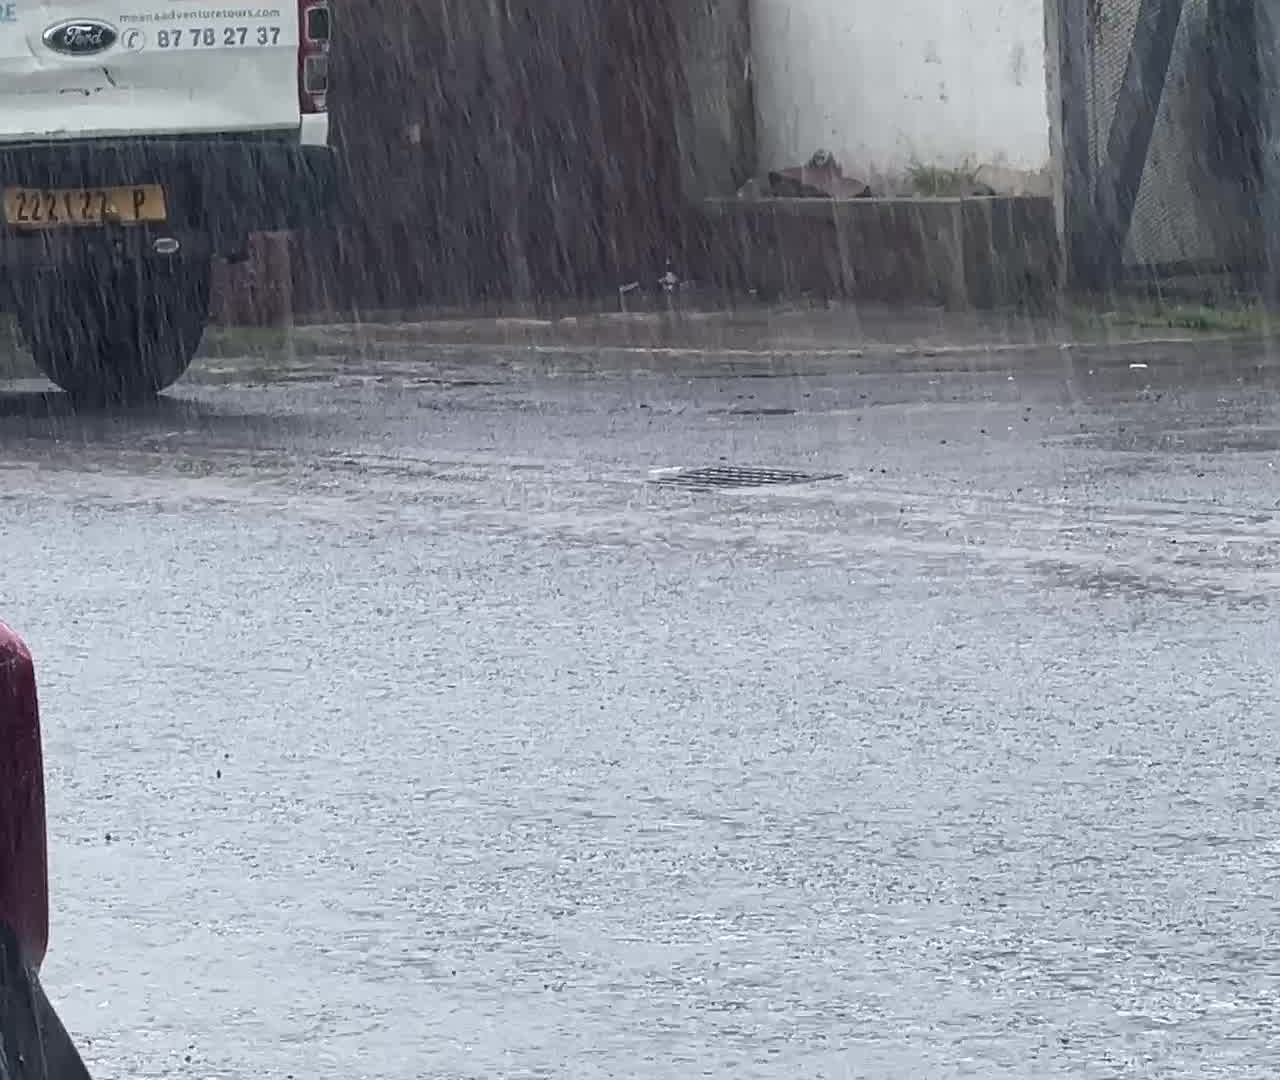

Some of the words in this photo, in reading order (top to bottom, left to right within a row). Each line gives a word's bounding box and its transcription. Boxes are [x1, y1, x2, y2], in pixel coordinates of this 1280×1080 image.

[119, 7, 281, 24] moanaadventuretours.com
[157, 29, 183, 49] 87
[223, 27, 249, 46] 27
[256, 26, 281, 46] 37
[133, 189, 145, 219] P
